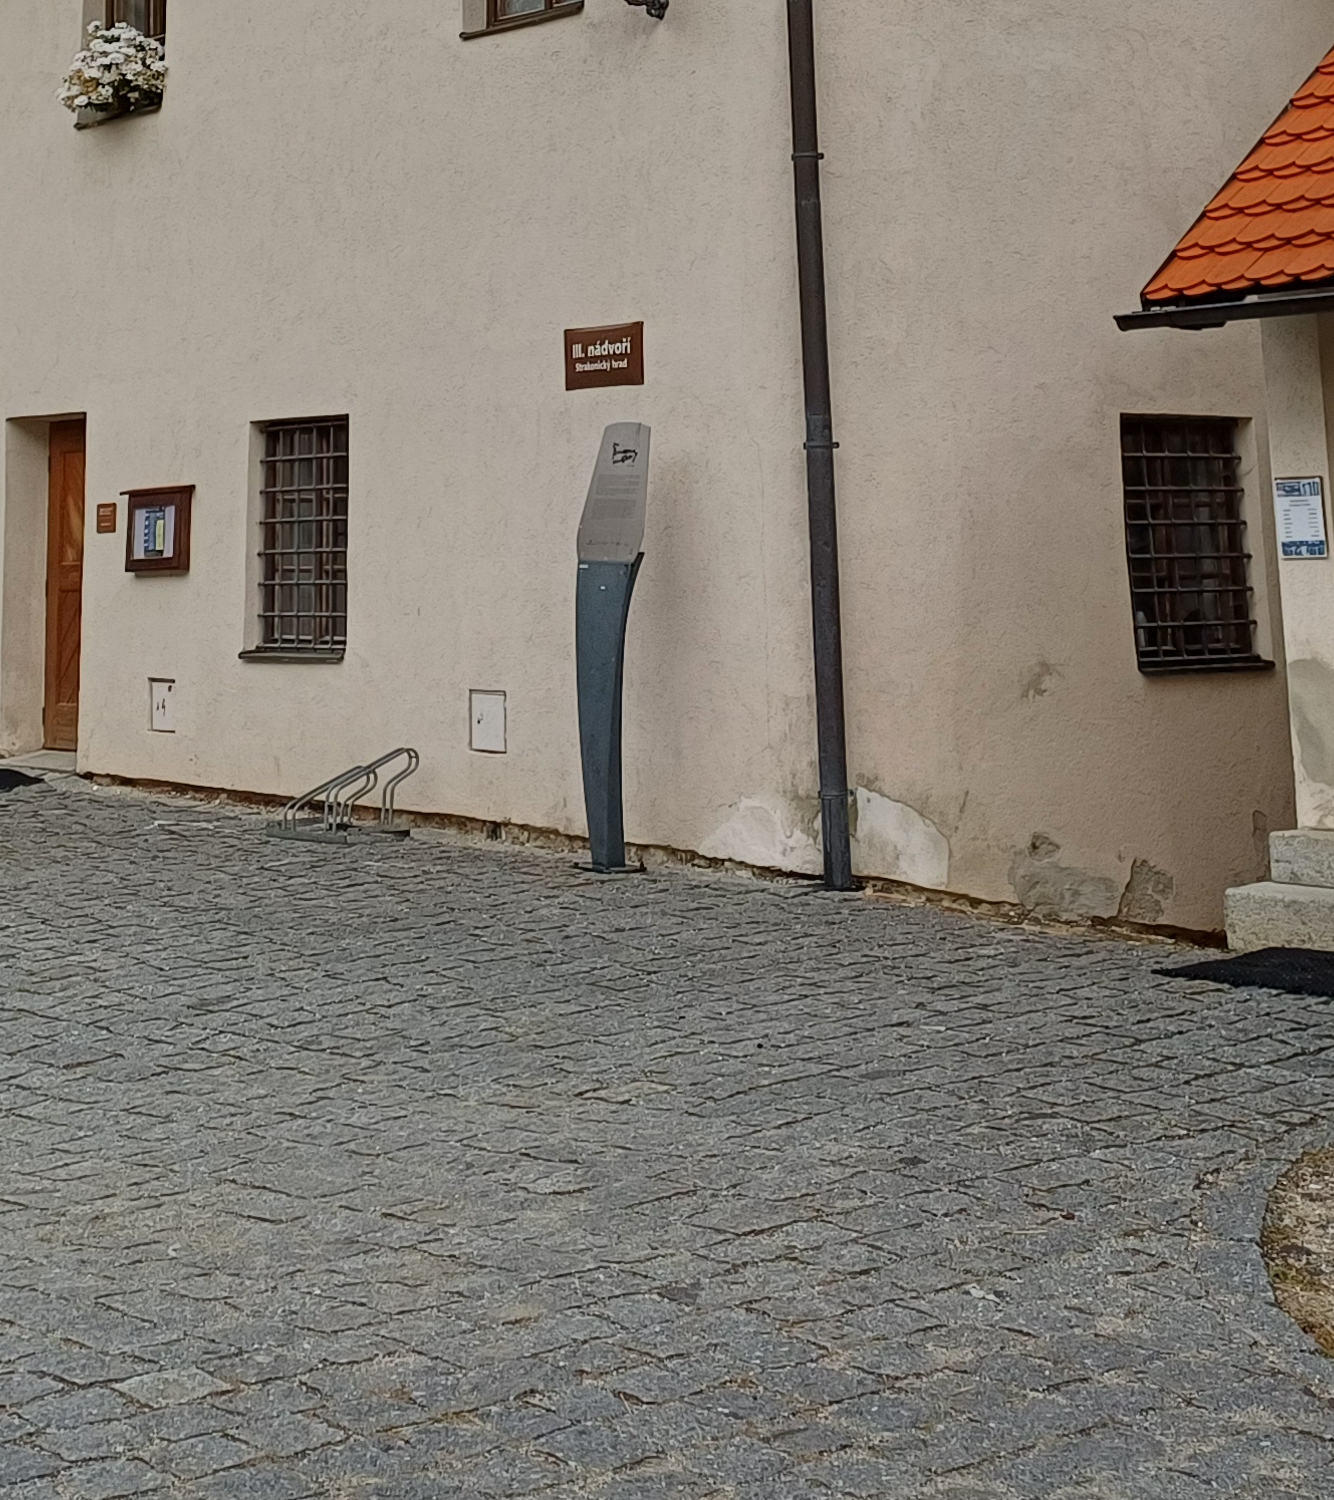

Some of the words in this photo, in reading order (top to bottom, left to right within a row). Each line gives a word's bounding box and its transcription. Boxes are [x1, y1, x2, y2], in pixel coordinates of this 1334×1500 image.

[572, 343, 585, 359] III.
[587, 337, 631, 357] nádvoří
[575, 359, 611, 372] Strakonický
[612, 358, 628, 369] hrad
